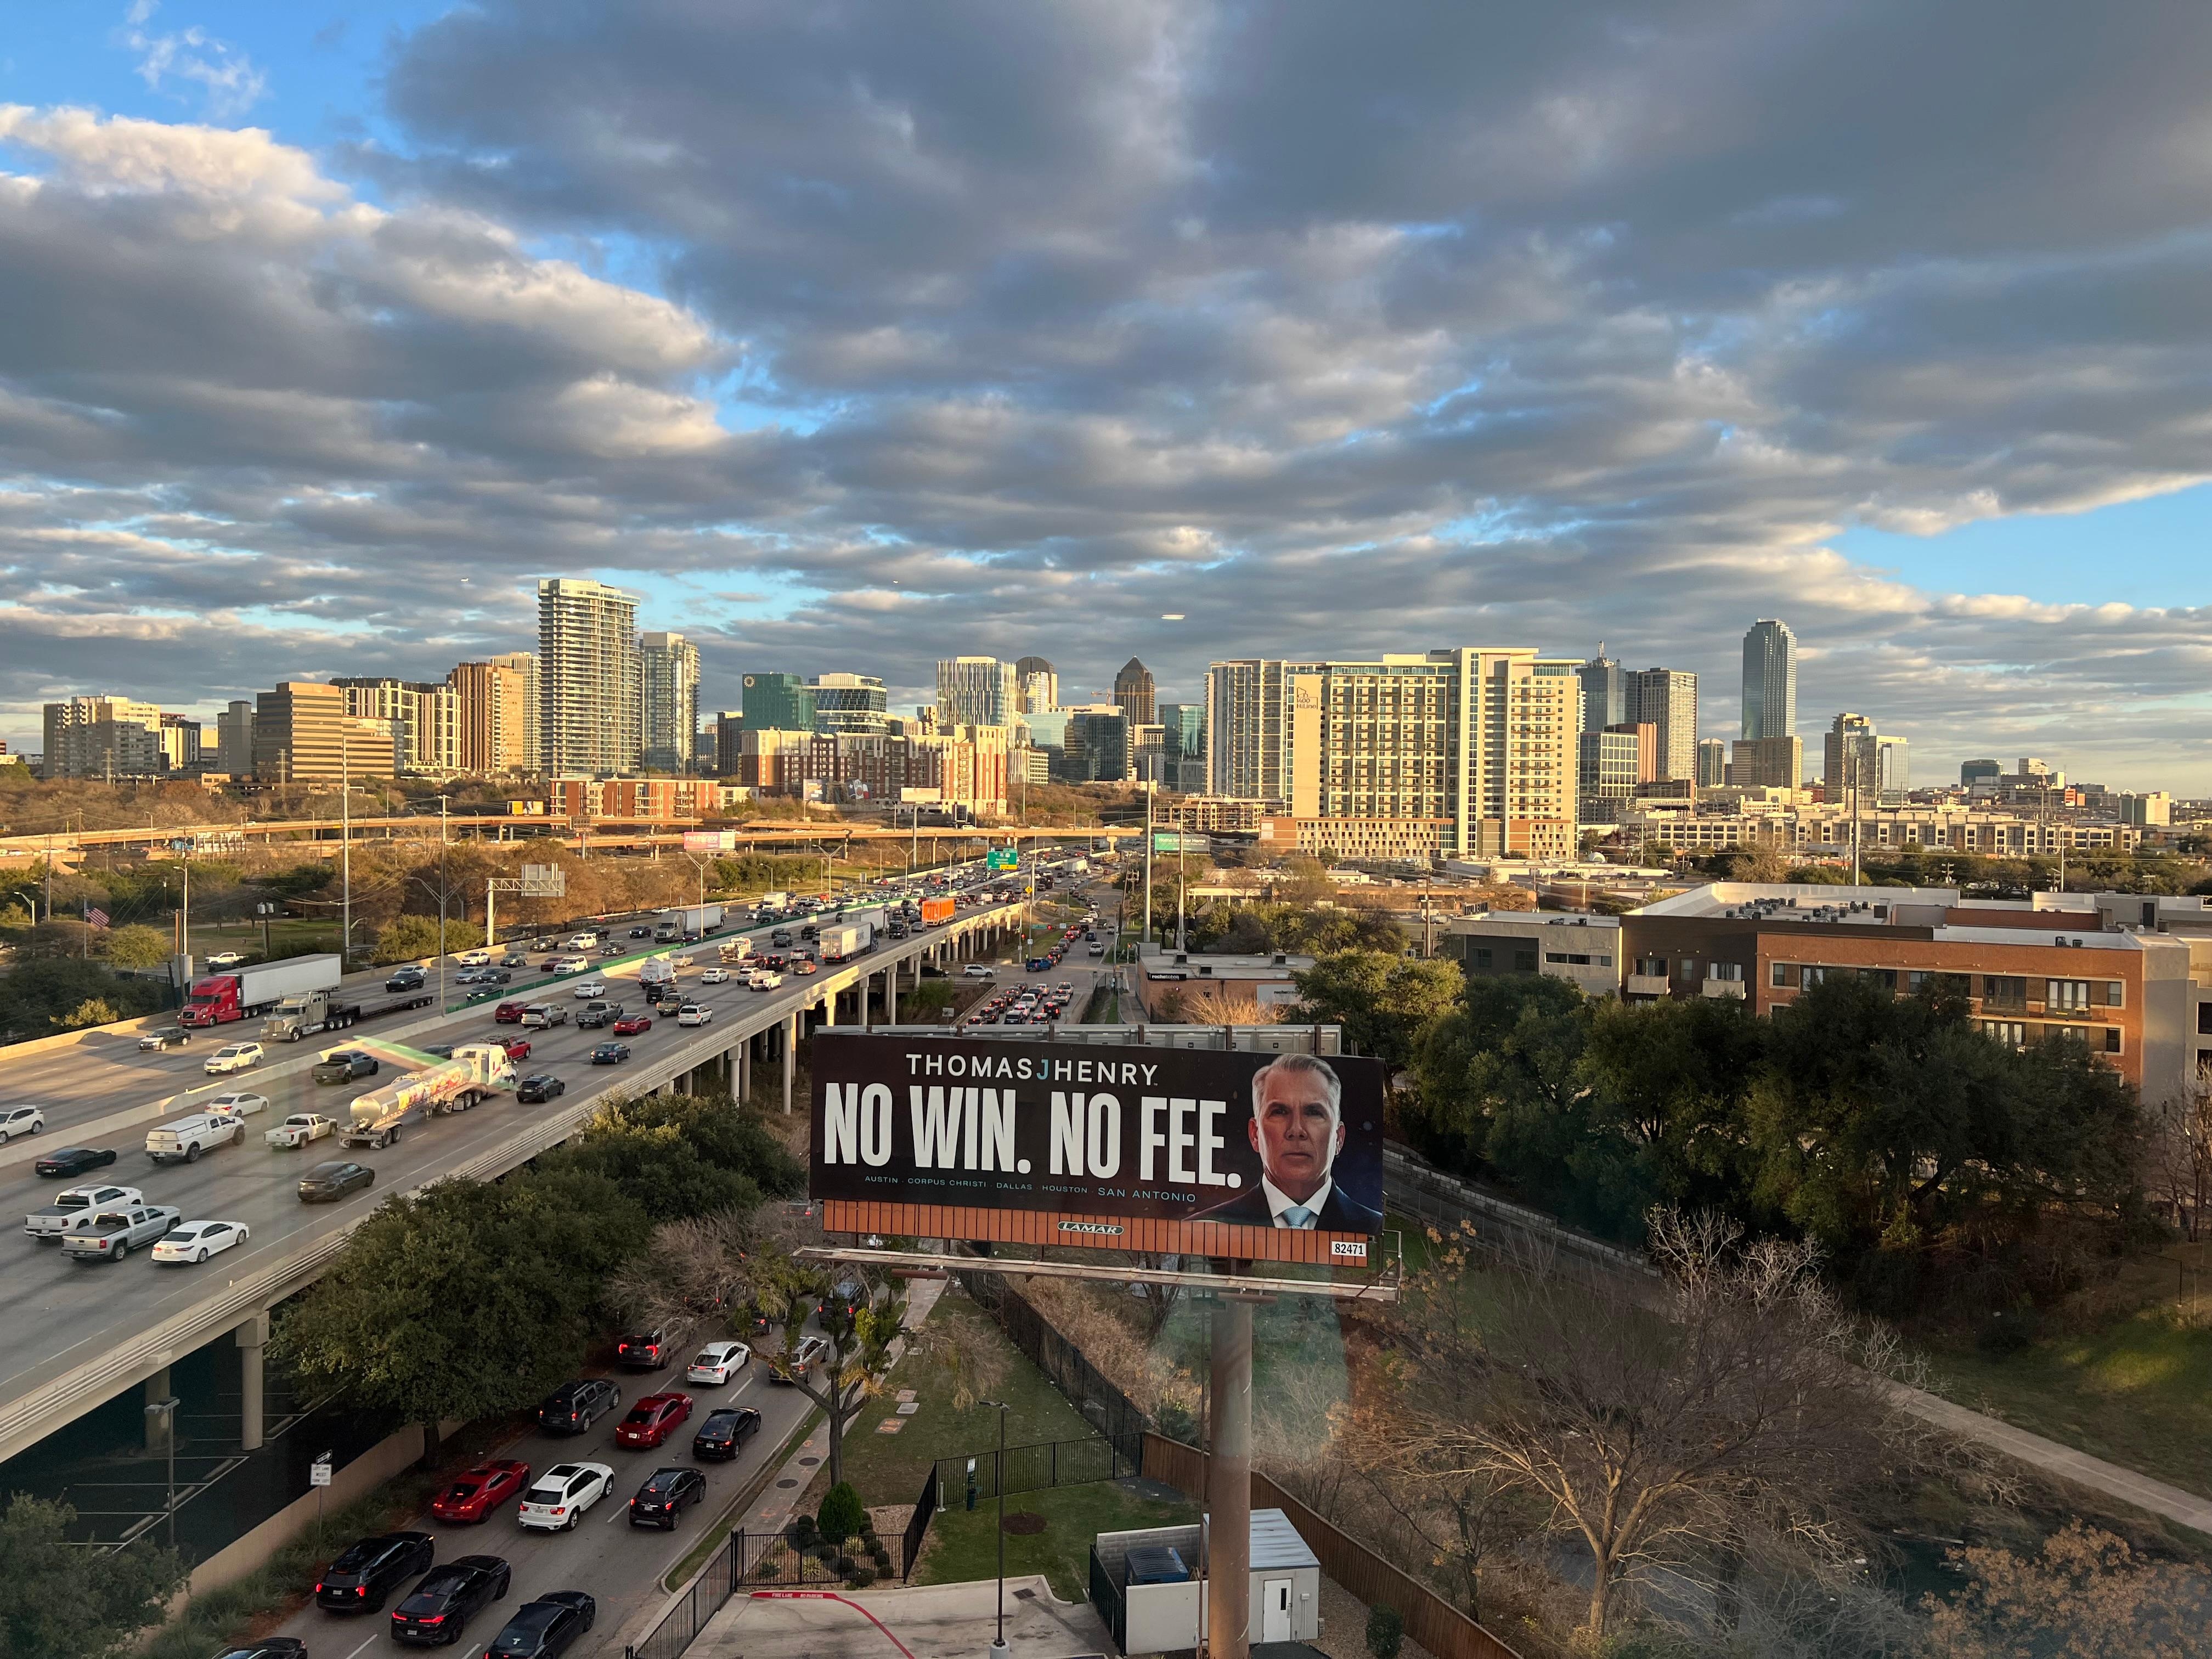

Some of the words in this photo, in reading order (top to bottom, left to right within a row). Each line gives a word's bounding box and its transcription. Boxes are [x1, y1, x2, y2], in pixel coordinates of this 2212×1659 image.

[824, 1082, 893, 1167] NO
[909, 1085, 1031, 1174] WIN.
[1049, 1091, 1121, 1179] NO
[1139, 1096, 1242, 1189] FEE.
[865, 1176, 898, 1184] AUSTIN
[949, 1180, 986, 1188] CHRISTI
[1042, 1185, 1087, 1193] HOUSTON
[1098, 1187, 1125, 1198] SAN
[1132, 1190, 1196, 1203] ANTONIO
[1063, 1222, 1117, 1233] LAMAR
[1335, 1243, 1364, 1255] 82471
